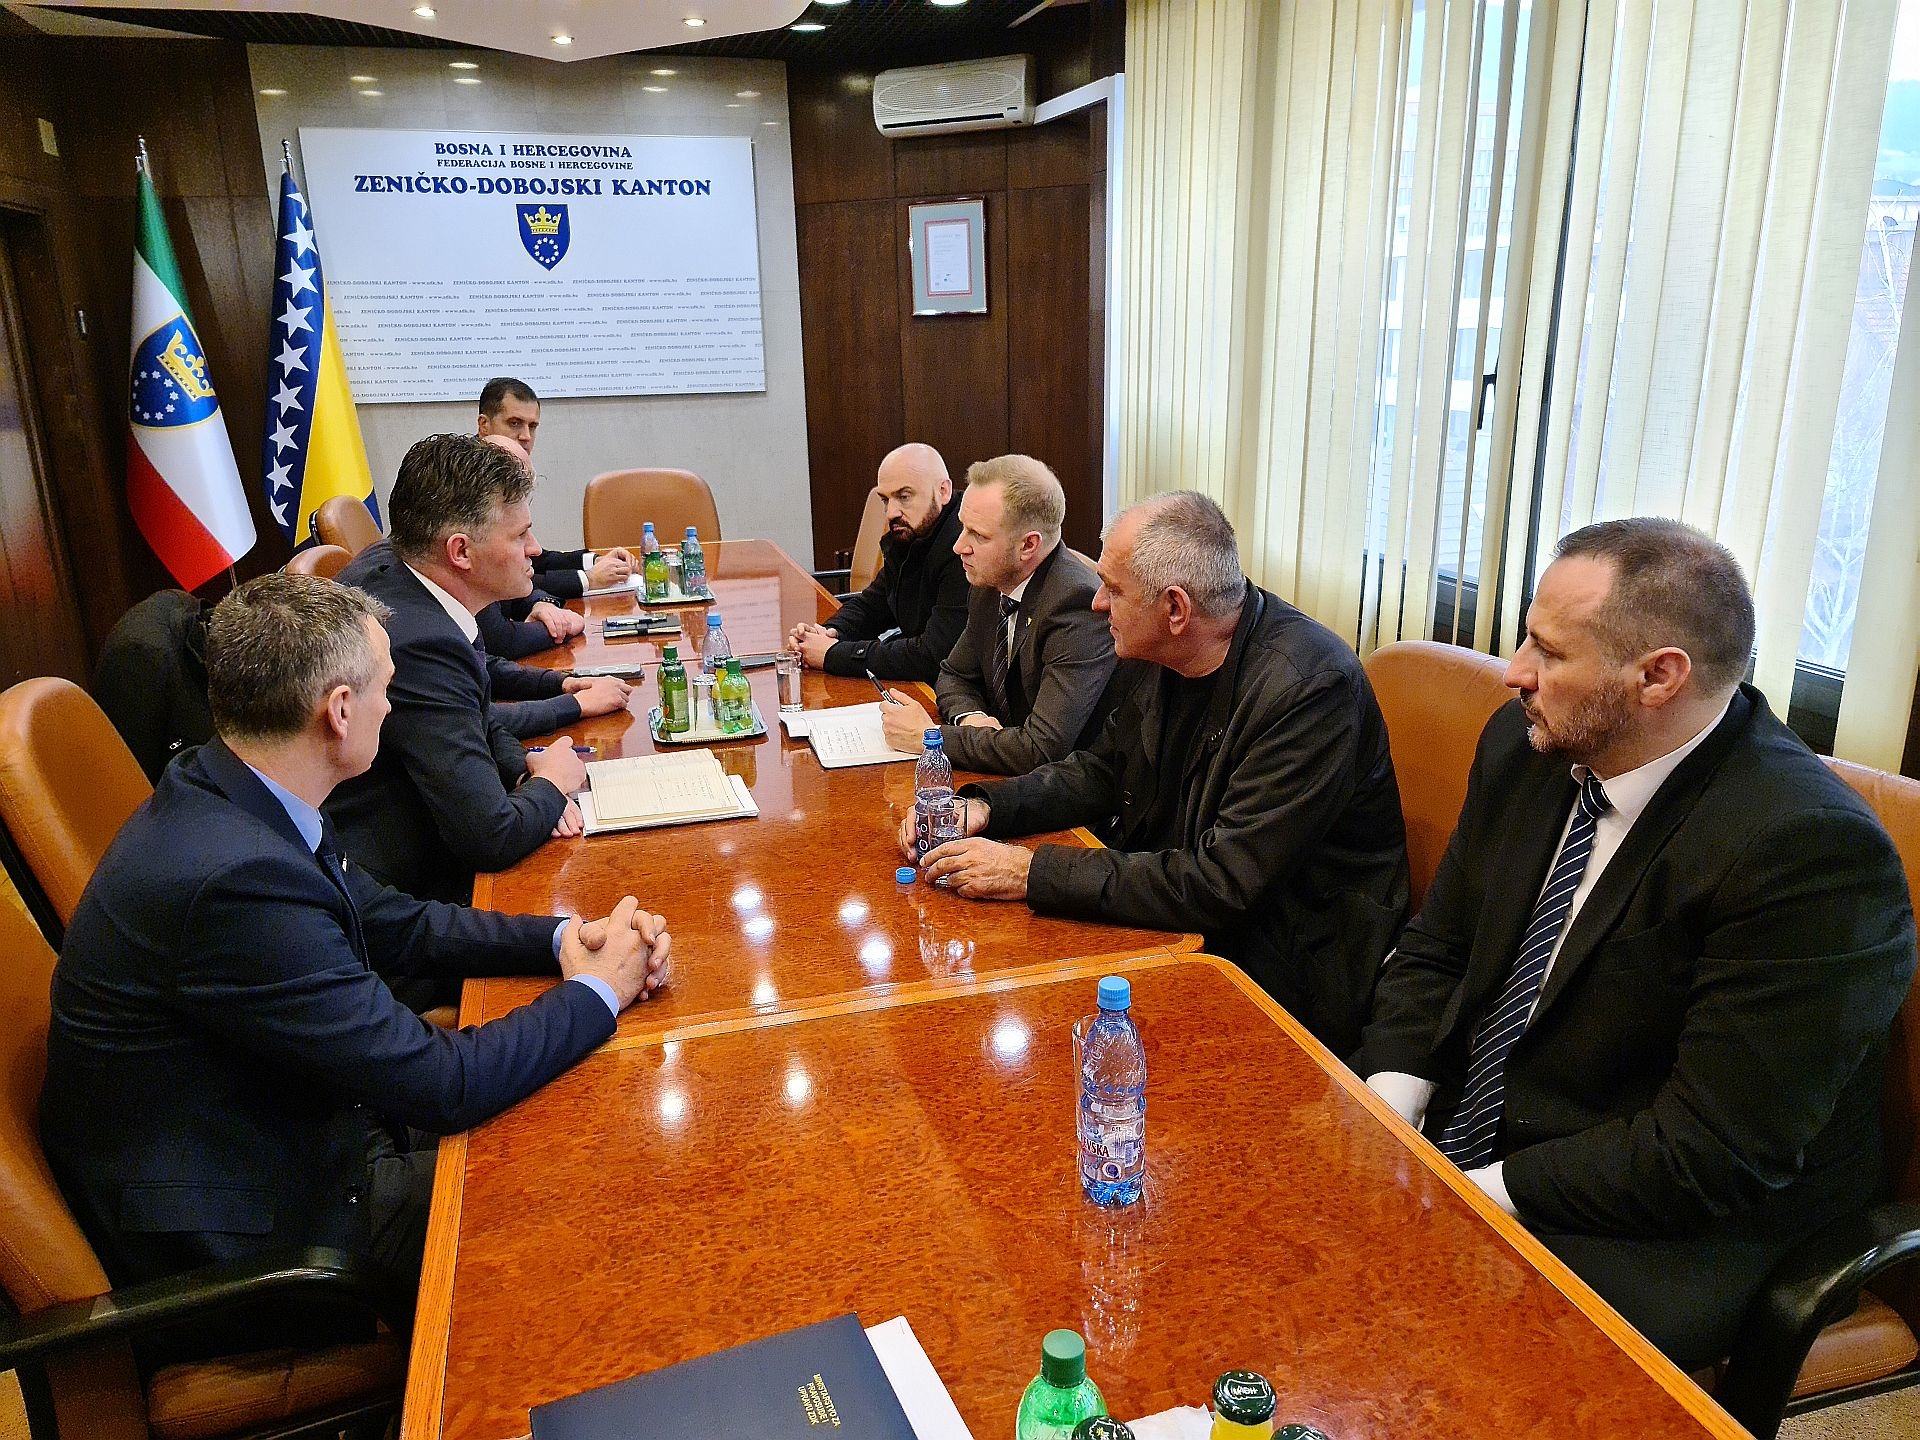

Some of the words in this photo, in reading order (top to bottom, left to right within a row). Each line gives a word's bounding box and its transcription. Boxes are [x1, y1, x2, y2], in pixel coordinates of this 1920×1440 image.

[434, 142, 494, 156] BOSNA
[499, 144, 507, 156] I
[512, 144, 633, 158] HERCEGOVINA
[436, 159, 507, 168] FEDERACIJA
[510, 160, 546, 169] BOSNE
[550, 160, 555, 169] I
[558, 161, 634, 170] HERCEGOVINE
[354, 171, 603, 196] ZENIČKO-DOBOJSKI
[611, 179, 712, 196] KANTON
[807, 1410, 820, 1425] ZDK
